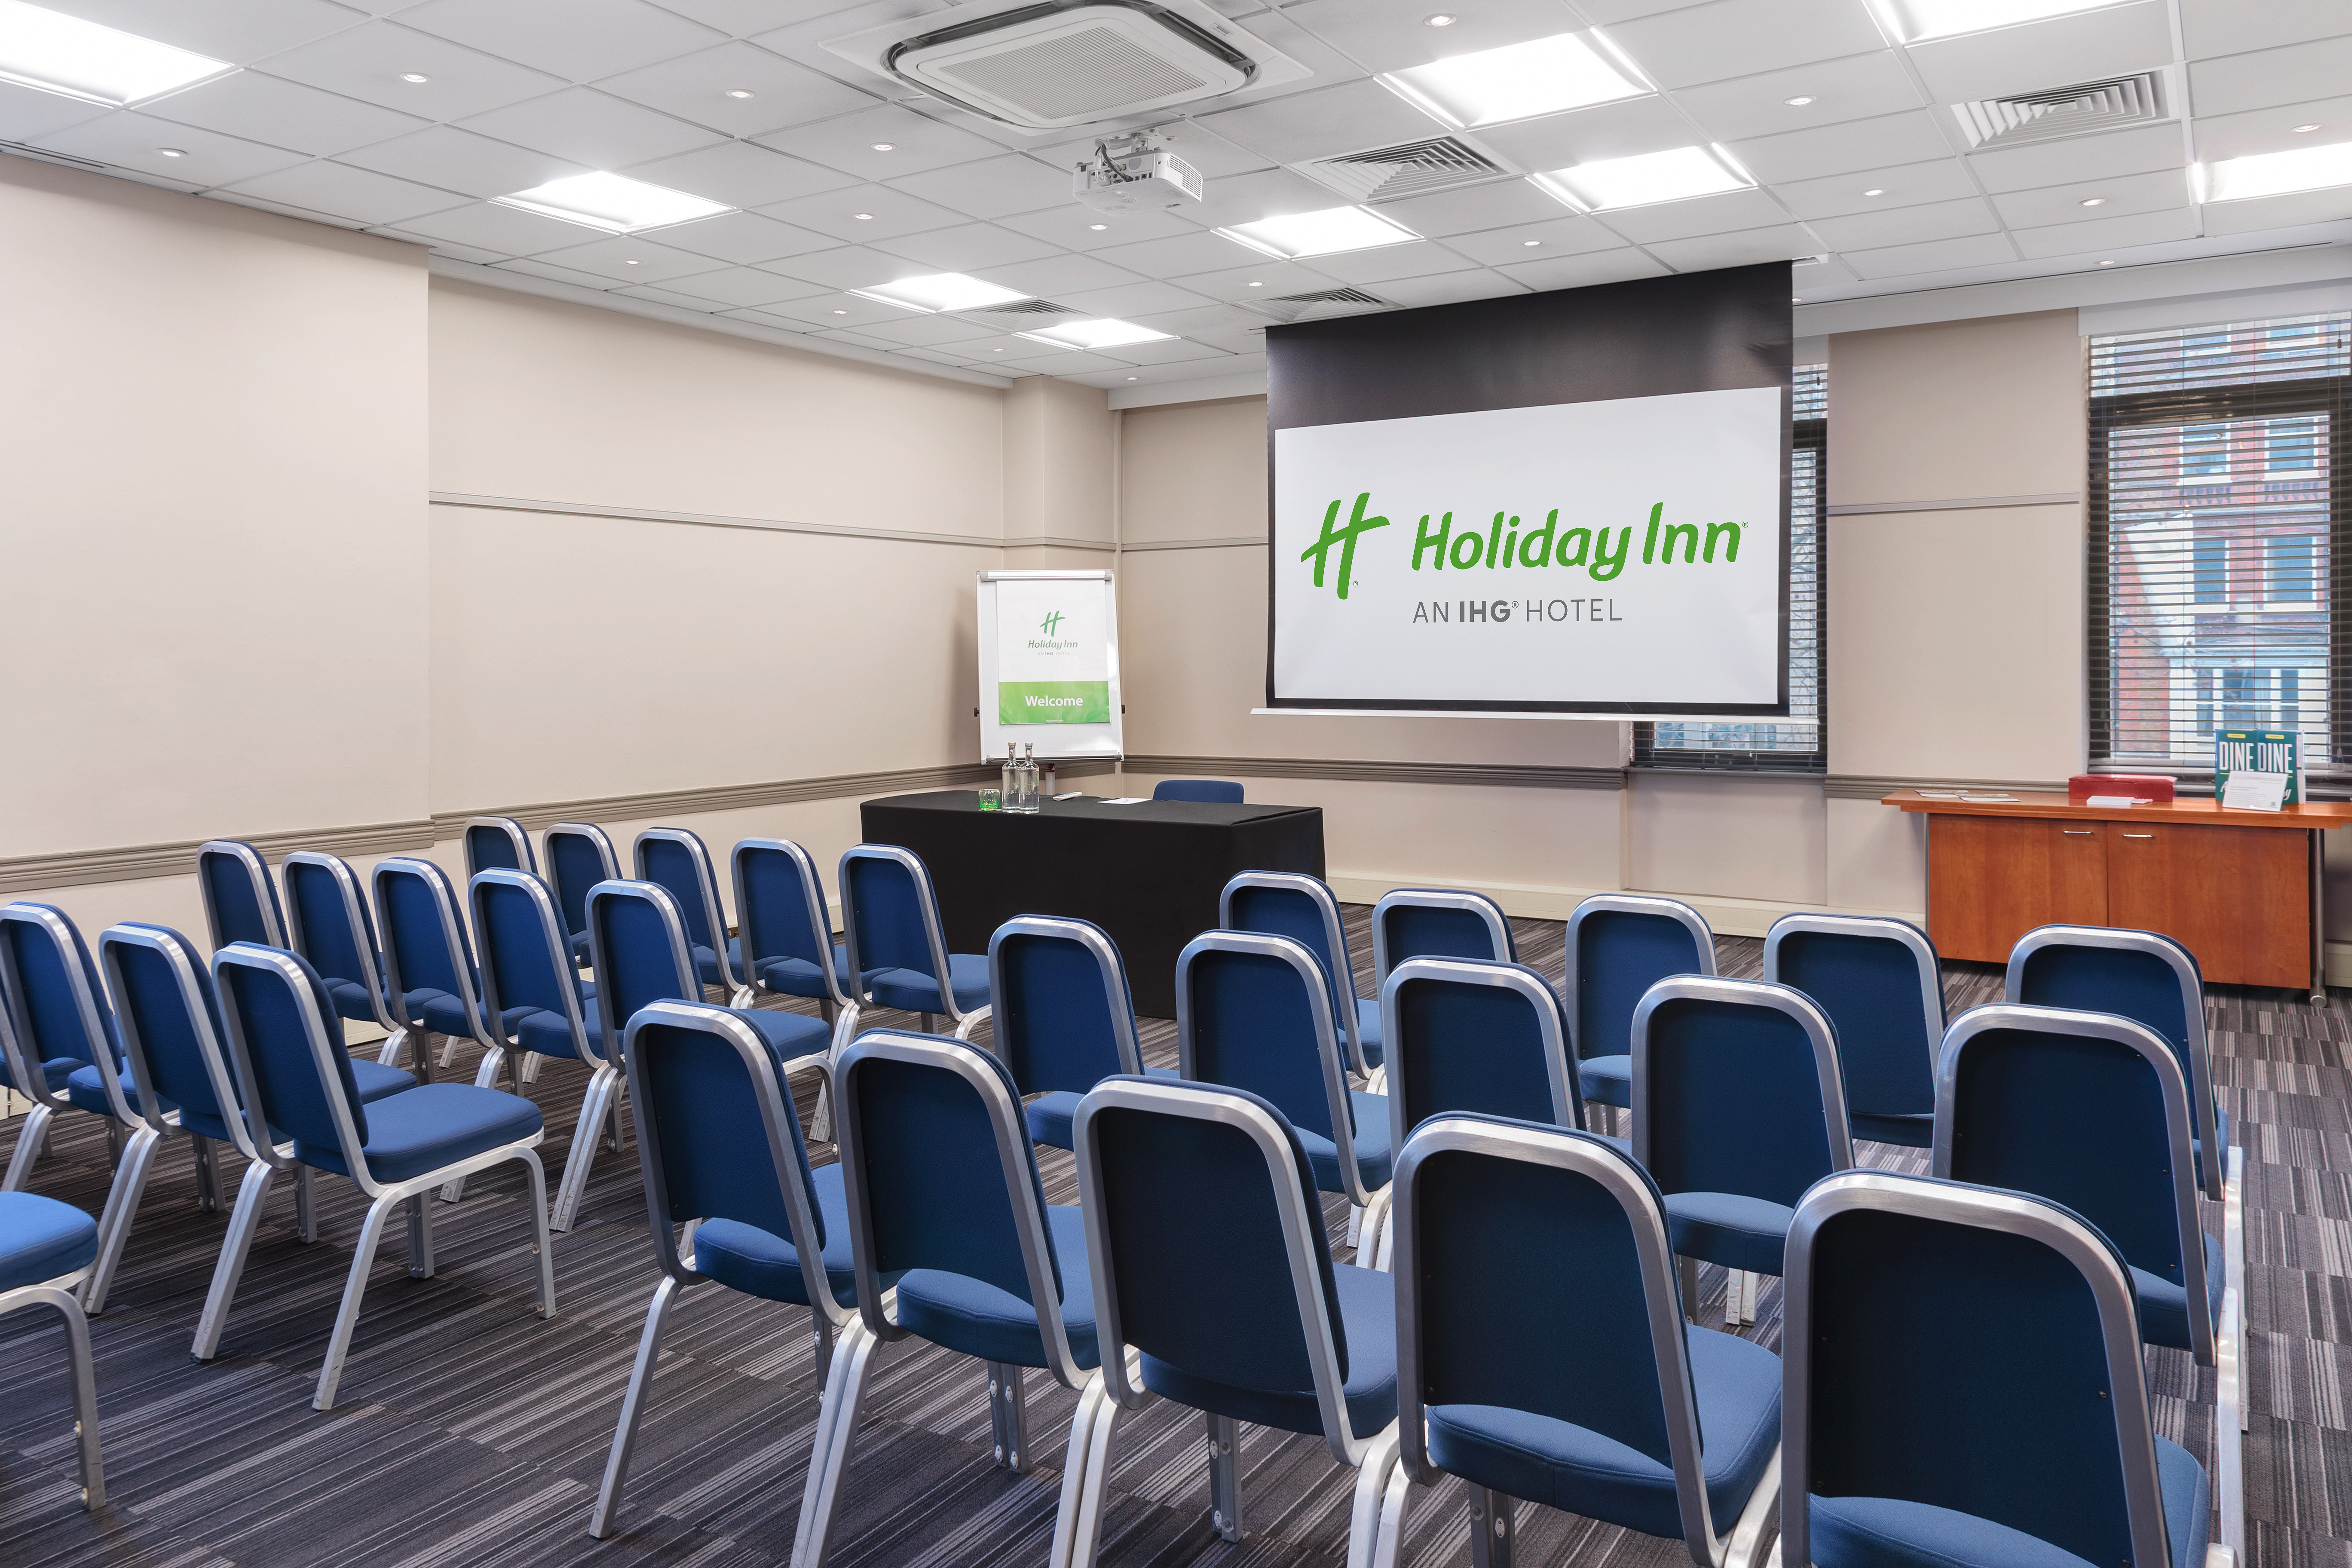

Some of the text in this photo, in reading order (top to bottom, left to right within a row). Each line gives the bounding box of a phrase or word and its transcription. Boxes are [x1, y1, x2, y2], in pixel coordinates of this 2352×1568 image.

[1412, 509, 1632, 582] Holiday
[1413, 601, 1449, 623] AN
[1527, 598, 1623, 622] HOTEL
[1028, 639, 1078, 650] Holiday Inn
[1025, 695, 1083, 707] Welcome
[2219, 741, 2254, 772] DINE
[2257, 742, 2293, 773] DINE
